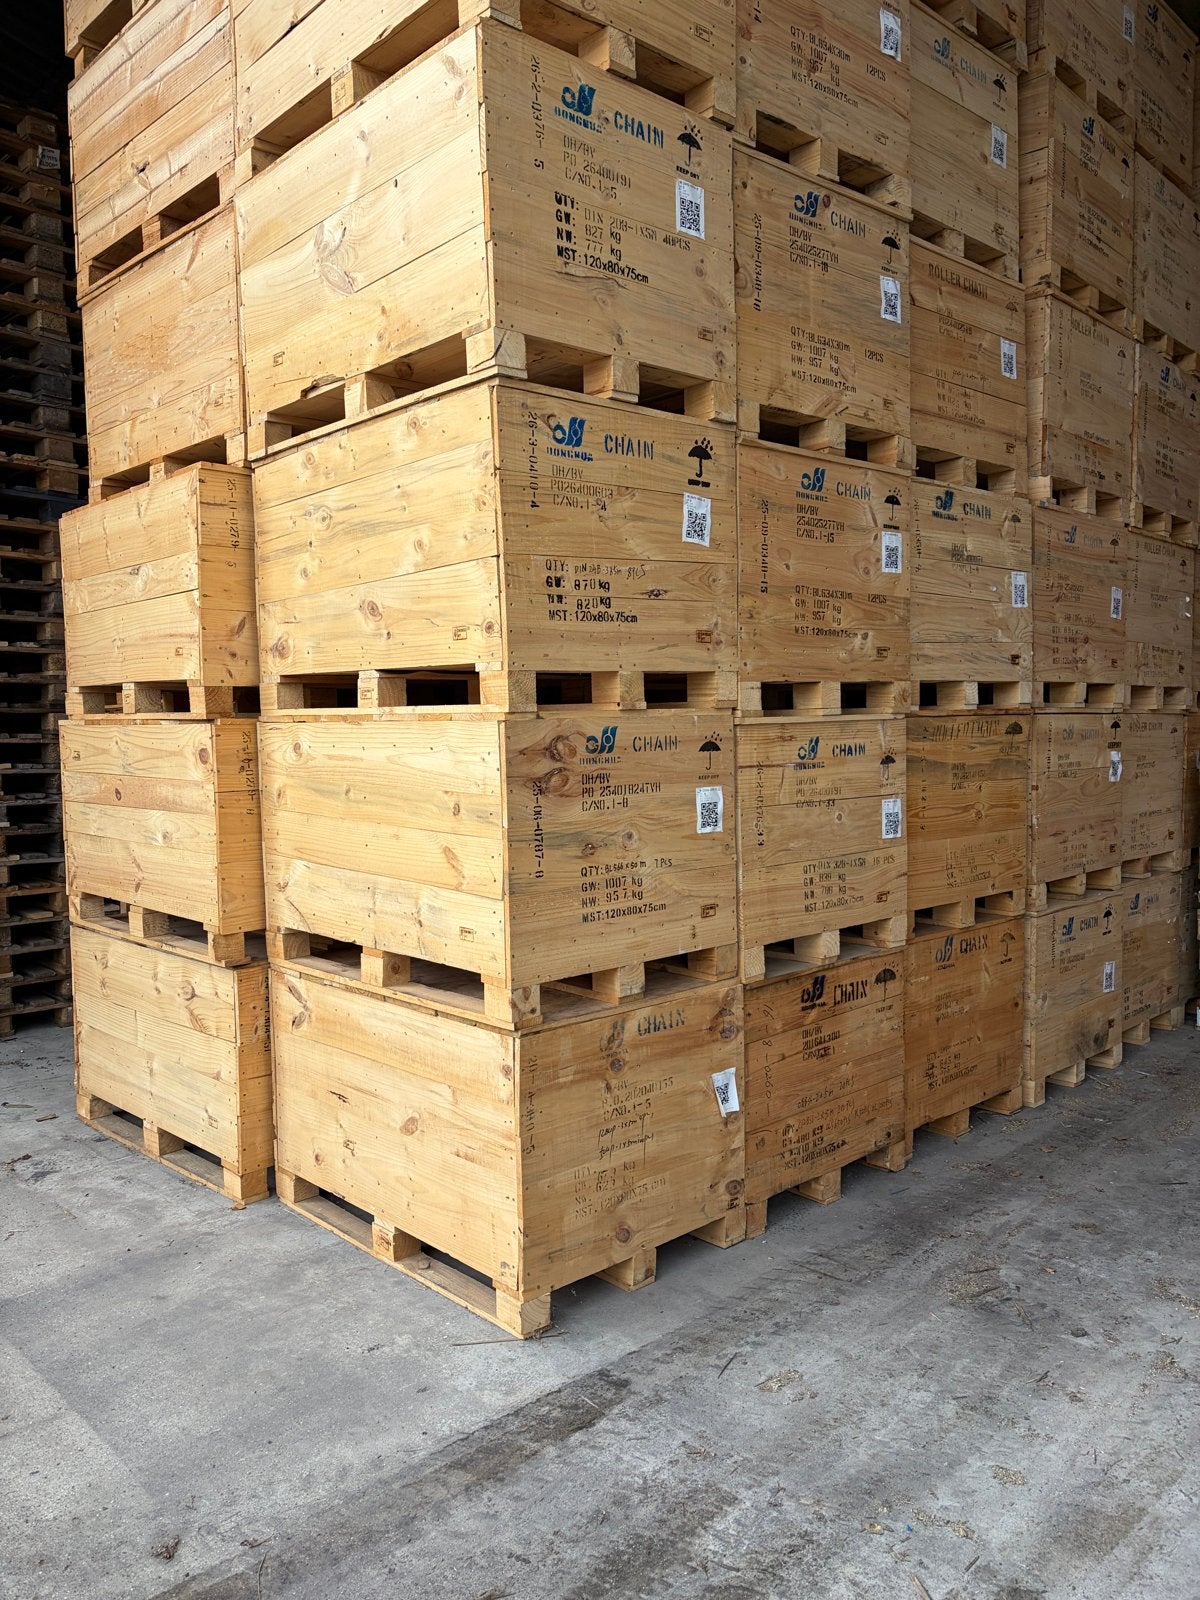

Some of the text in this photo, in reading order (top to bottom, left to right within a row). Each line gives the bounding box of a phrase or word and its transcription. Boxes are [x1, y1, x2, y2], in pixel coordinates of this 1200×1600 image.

[810, 46, 828, 63] 1007
[830, 60, 840, 74] kg
[866, 63, 886, 81] 12PCS
[960, 56, 987, 84] CHAIN
[614, 110, 664, 149] CHAIN
[534, 158, 545, 170] 5
[563, 151, 577, 167] PO
[676, 165, 690, 176] KEEP
[554, 191, 579, 211] QTY:
[555, 209, 622, 244] GW: 827 kg
[830, 210, 866, 238] CHAIN
[556, 226, 622, 261] NW: 777 kg
[928, 262, 961, 288] ROLLER
[809, 345, 827, 358] 1007
[829, 351, 839, 364] kg
[864, 348, 884, 363] 12PCS
[808, 356, 823, 368] 957
[829, 364, 839, 376] kg
[604, 433, 654, 460] CHAIN
[528, 411, 540, 509] 26-3-0410-4
[836, 481, 871, 501] CHAIN
[796, 503, 819, 516] DH/BV
[963, 502, 992, 519] CHAIN
[545, 559, 569, 572] QTY:
[574, 579, 596, 590] 870
[598, 579, 610, 592] kg
[576, 598, 598, 610] 820
[600, 596, 611, 609] kg
[812, 599, 830, 612] 1007
[832, 603, 842, 614] kg
[867, 593, 887, 604] 12PCS
[812, 611, 826, 621] 957
[832, 615, 842, 626] kg
[632, 735, 679, 753] CHAIN
[832, 743, 866, 758] CHAIN
[581, 786, 594, 798] PO
[580, 865, 603, 878] QTY:
[838, 873, 846, 882] kg
[581, 876, 643, 892] GW: 1007 kg
[838, 885, 847, 894] kg
[581, 888, 643, 908] NW: 957 kg
[1080, 915, 1099, 932] CHAIN
[960, 934, 988, 954] CHAIN
[833, 979, 868, 1007] CHAIN
[637, 1008, 685, 1037] CHAIN
